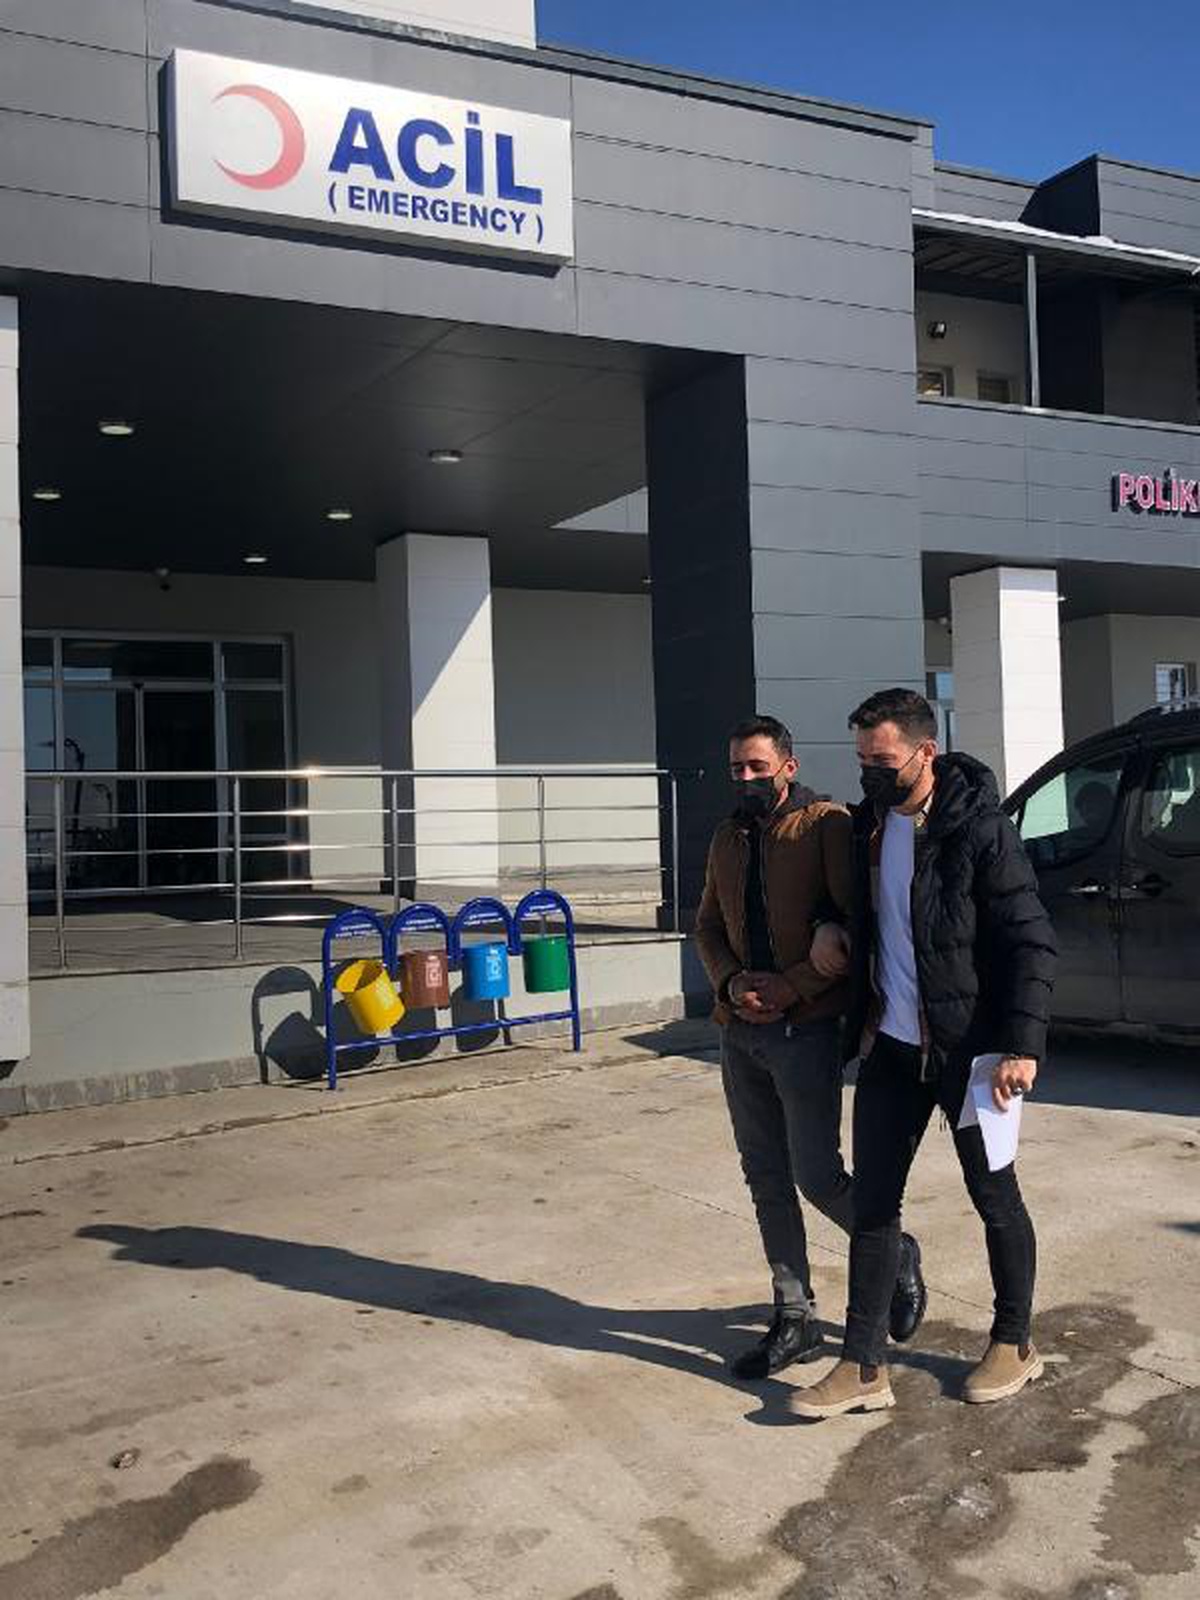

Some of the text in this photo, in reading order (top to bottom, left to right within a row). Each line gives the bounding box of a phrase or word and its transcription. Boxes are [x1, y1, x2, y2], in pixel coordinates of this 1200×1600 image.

[328, 107, 543, 205] ACİL
[348, 184, 526, 235] EMERGENCY
[1119, 467, 1200, 513] POLİK
